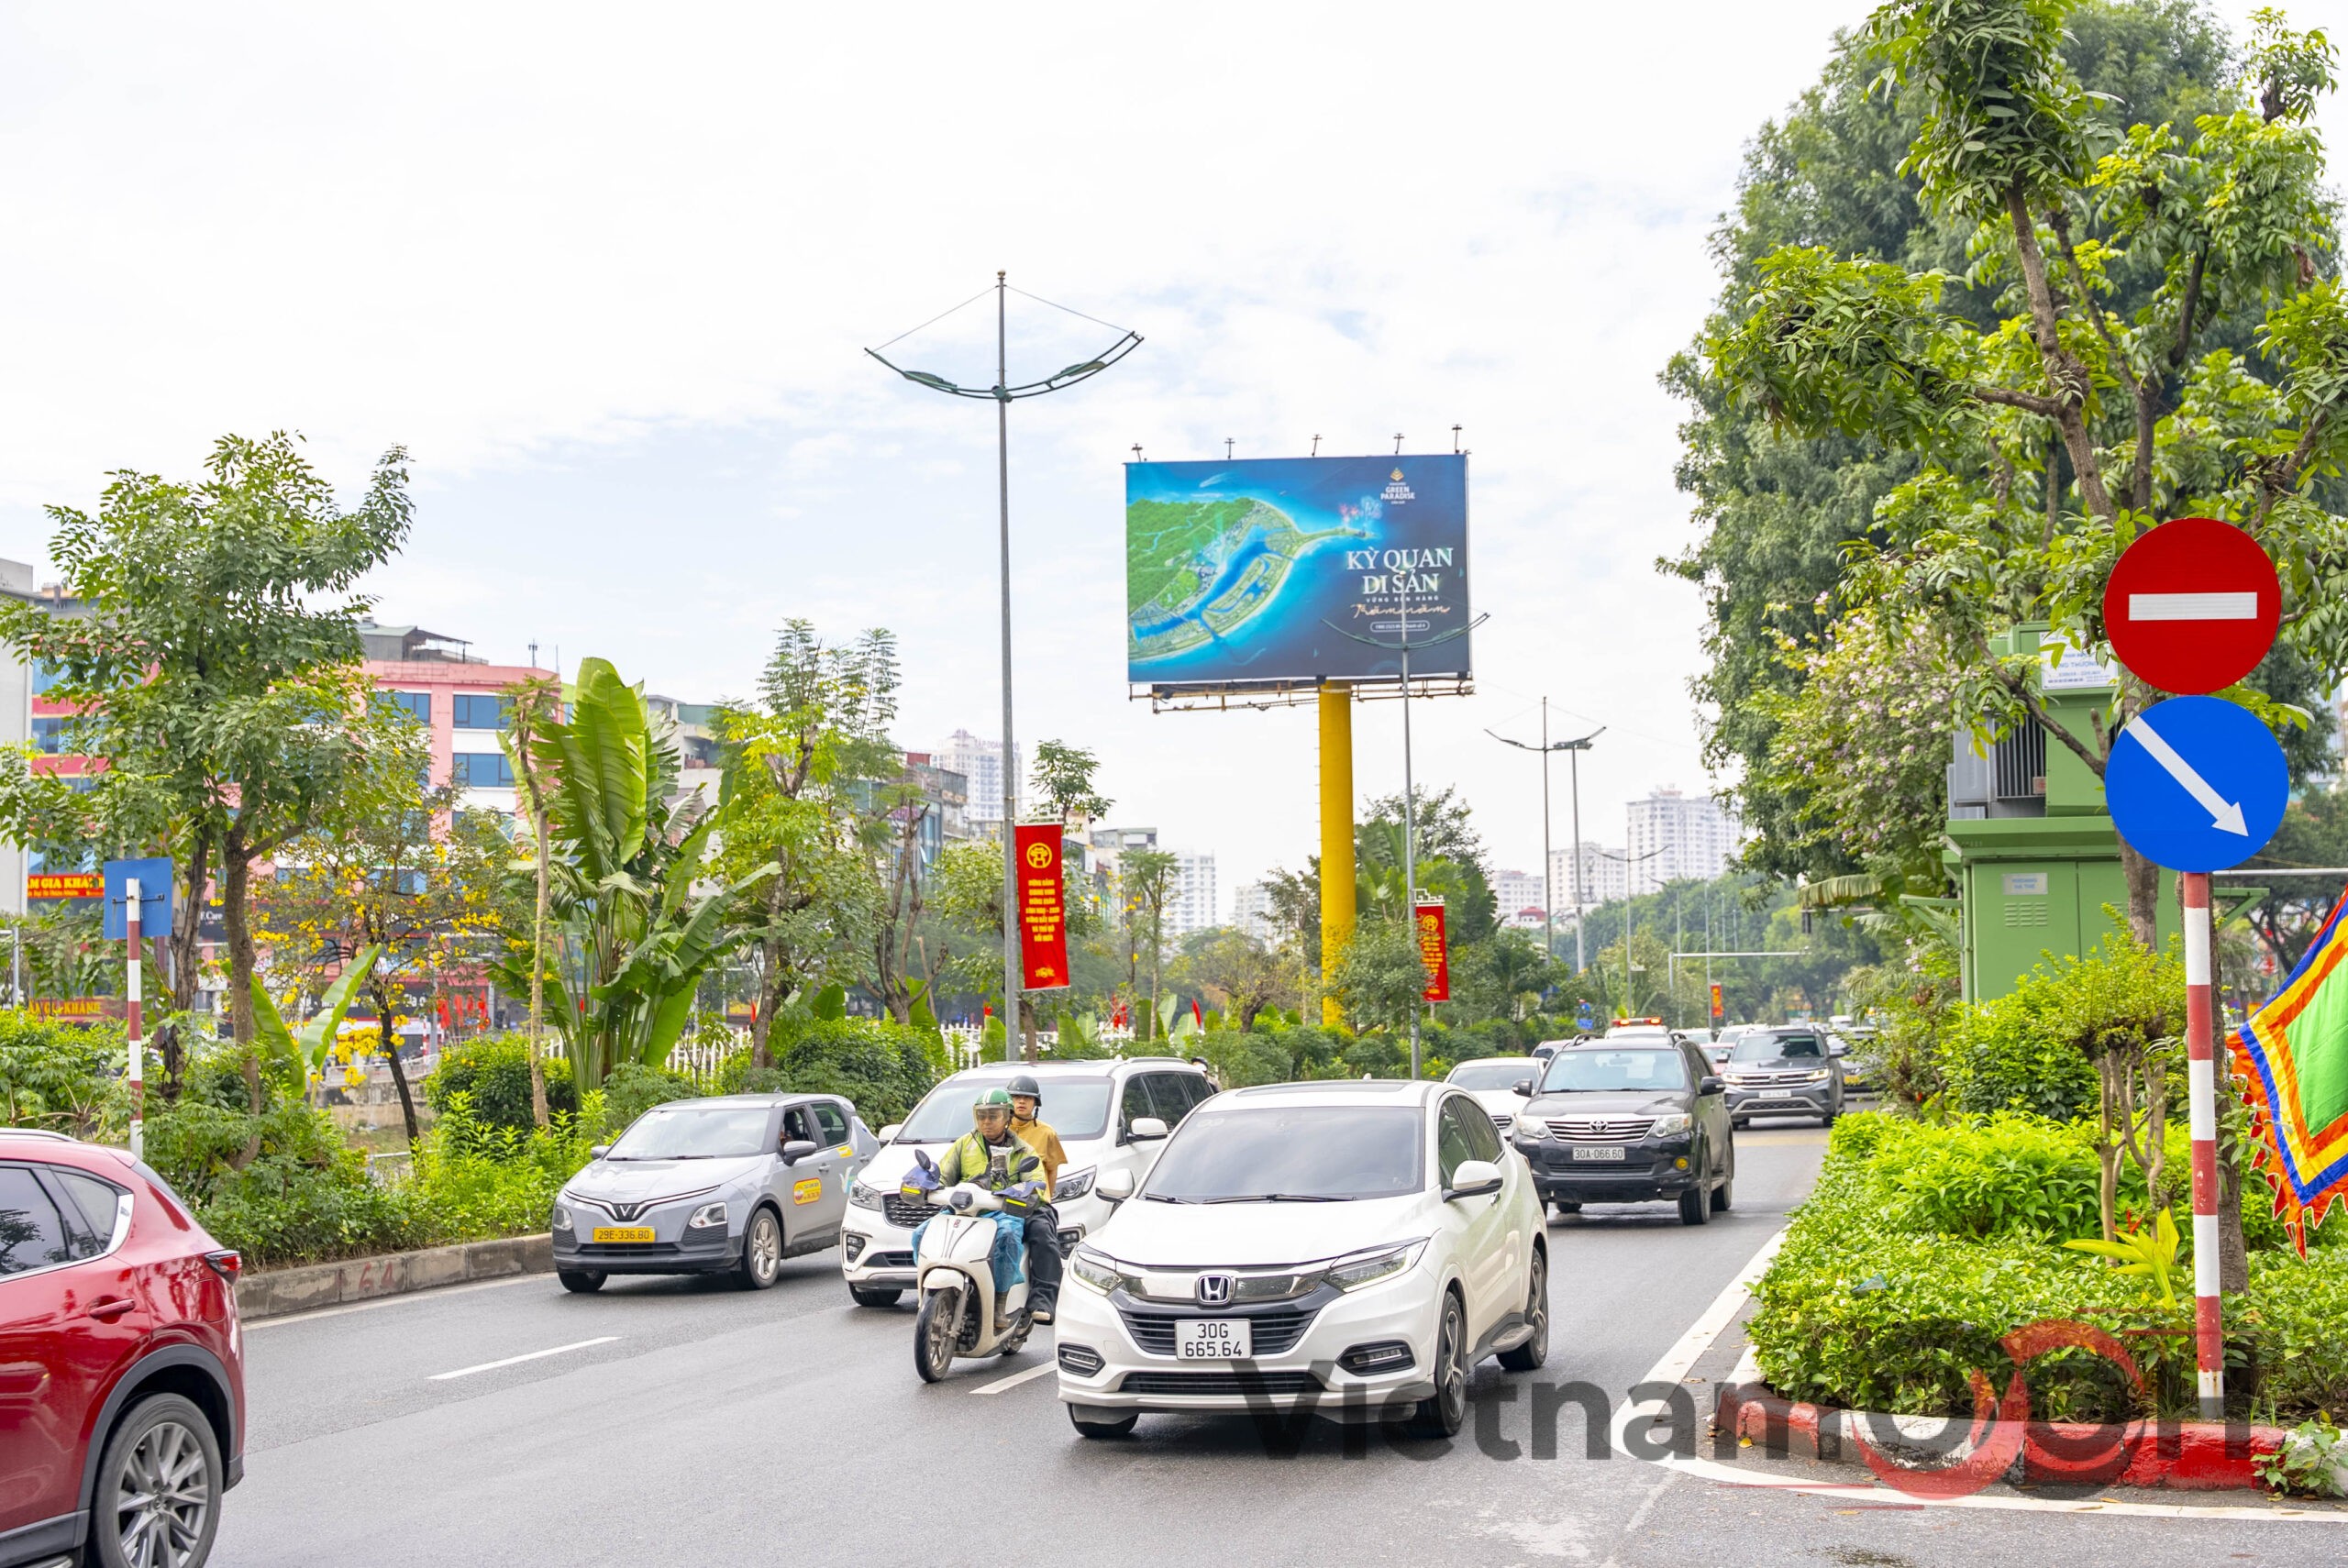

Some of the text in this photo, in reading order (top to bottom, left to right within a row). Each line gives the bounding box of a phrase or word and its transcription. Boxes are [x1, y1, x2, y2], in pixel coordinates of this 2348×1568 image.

[1380, 492, 1416, 501] PARADISE
[1346, 546, 1454, 573] KỲ QUAN
[1363, 569, 1439, 594] DI SẢN
[41, 878, 61, 889] GIA
[1575, 1149, 1623, 1159] 30A-066.60
[598, 1231, 650, 1240] 29E-336.80
[1197, 1323, 1229, 1339] 30G
[1185, 1341, 1243, 1357] 665.64
